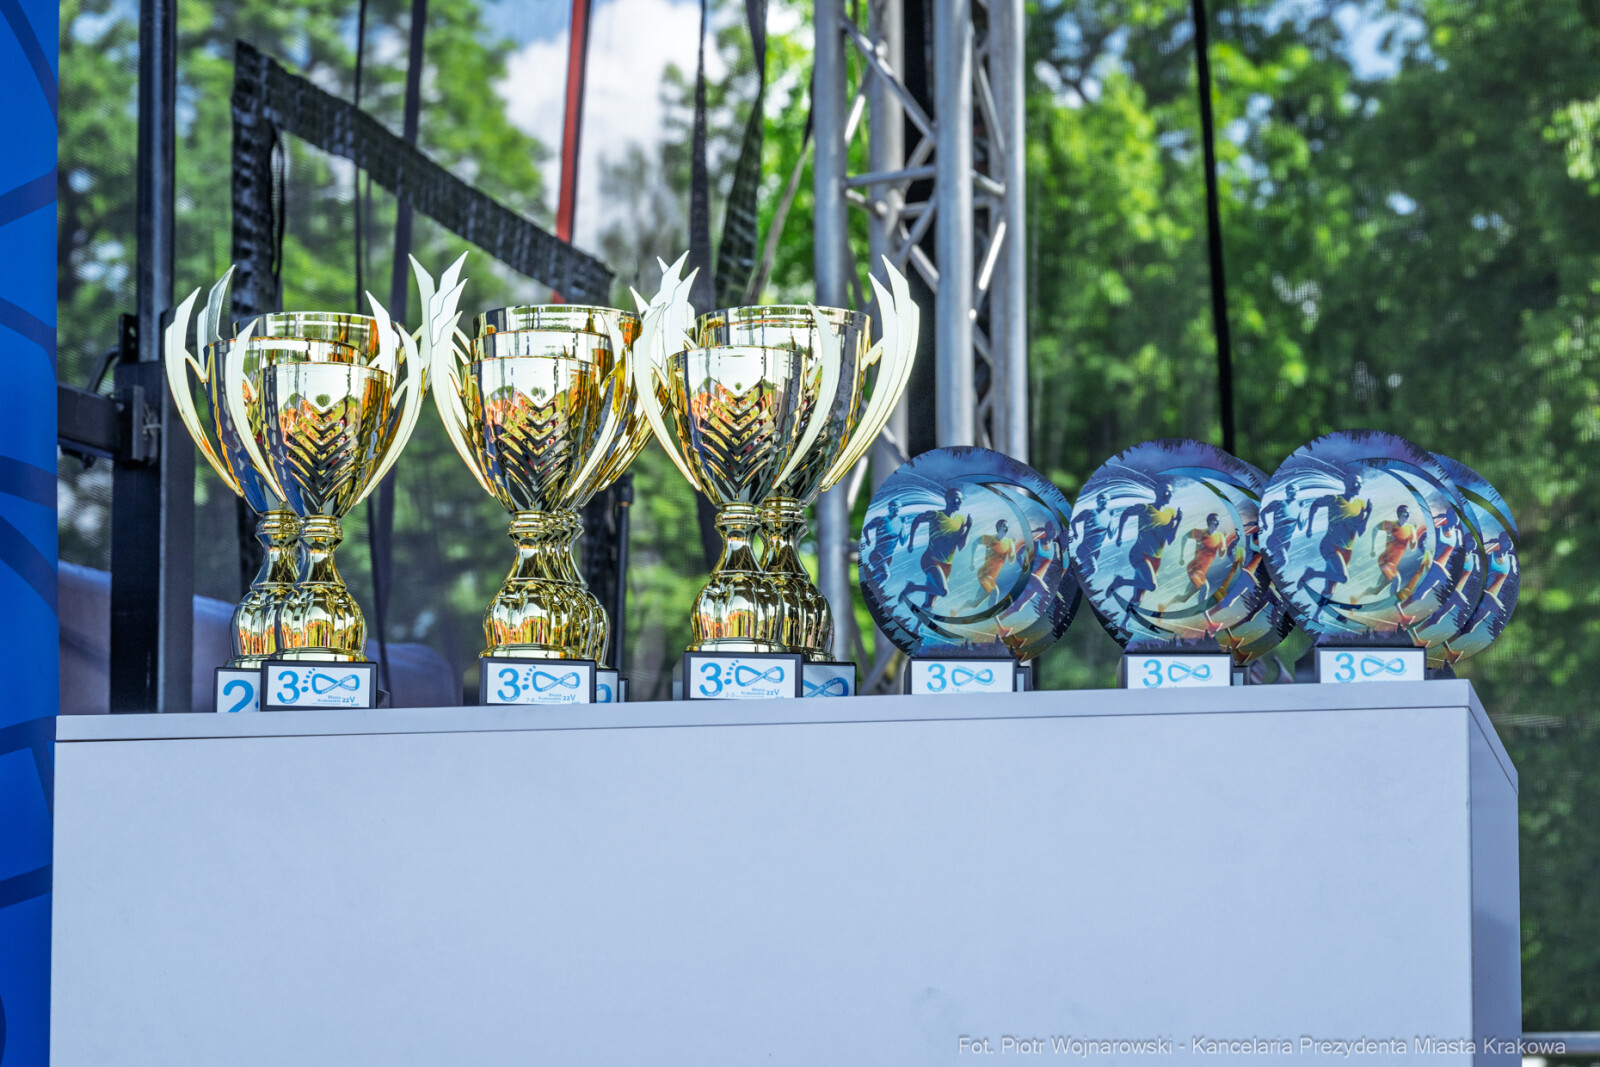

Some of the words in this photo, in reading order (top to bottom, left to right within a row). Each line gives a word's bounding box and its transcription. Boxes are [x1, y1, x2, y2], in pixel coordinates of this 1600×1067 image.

[700, 662, 723, 697] 3
[927, 663, 947, 692] 3
[1143, 659, 1163, 688] 3
[1335, 652, 1356, 683] 3
[223, 679, 254, 713] 2
[277, 670, 300, 704] 3
[497, 668, 521, 702] 3
